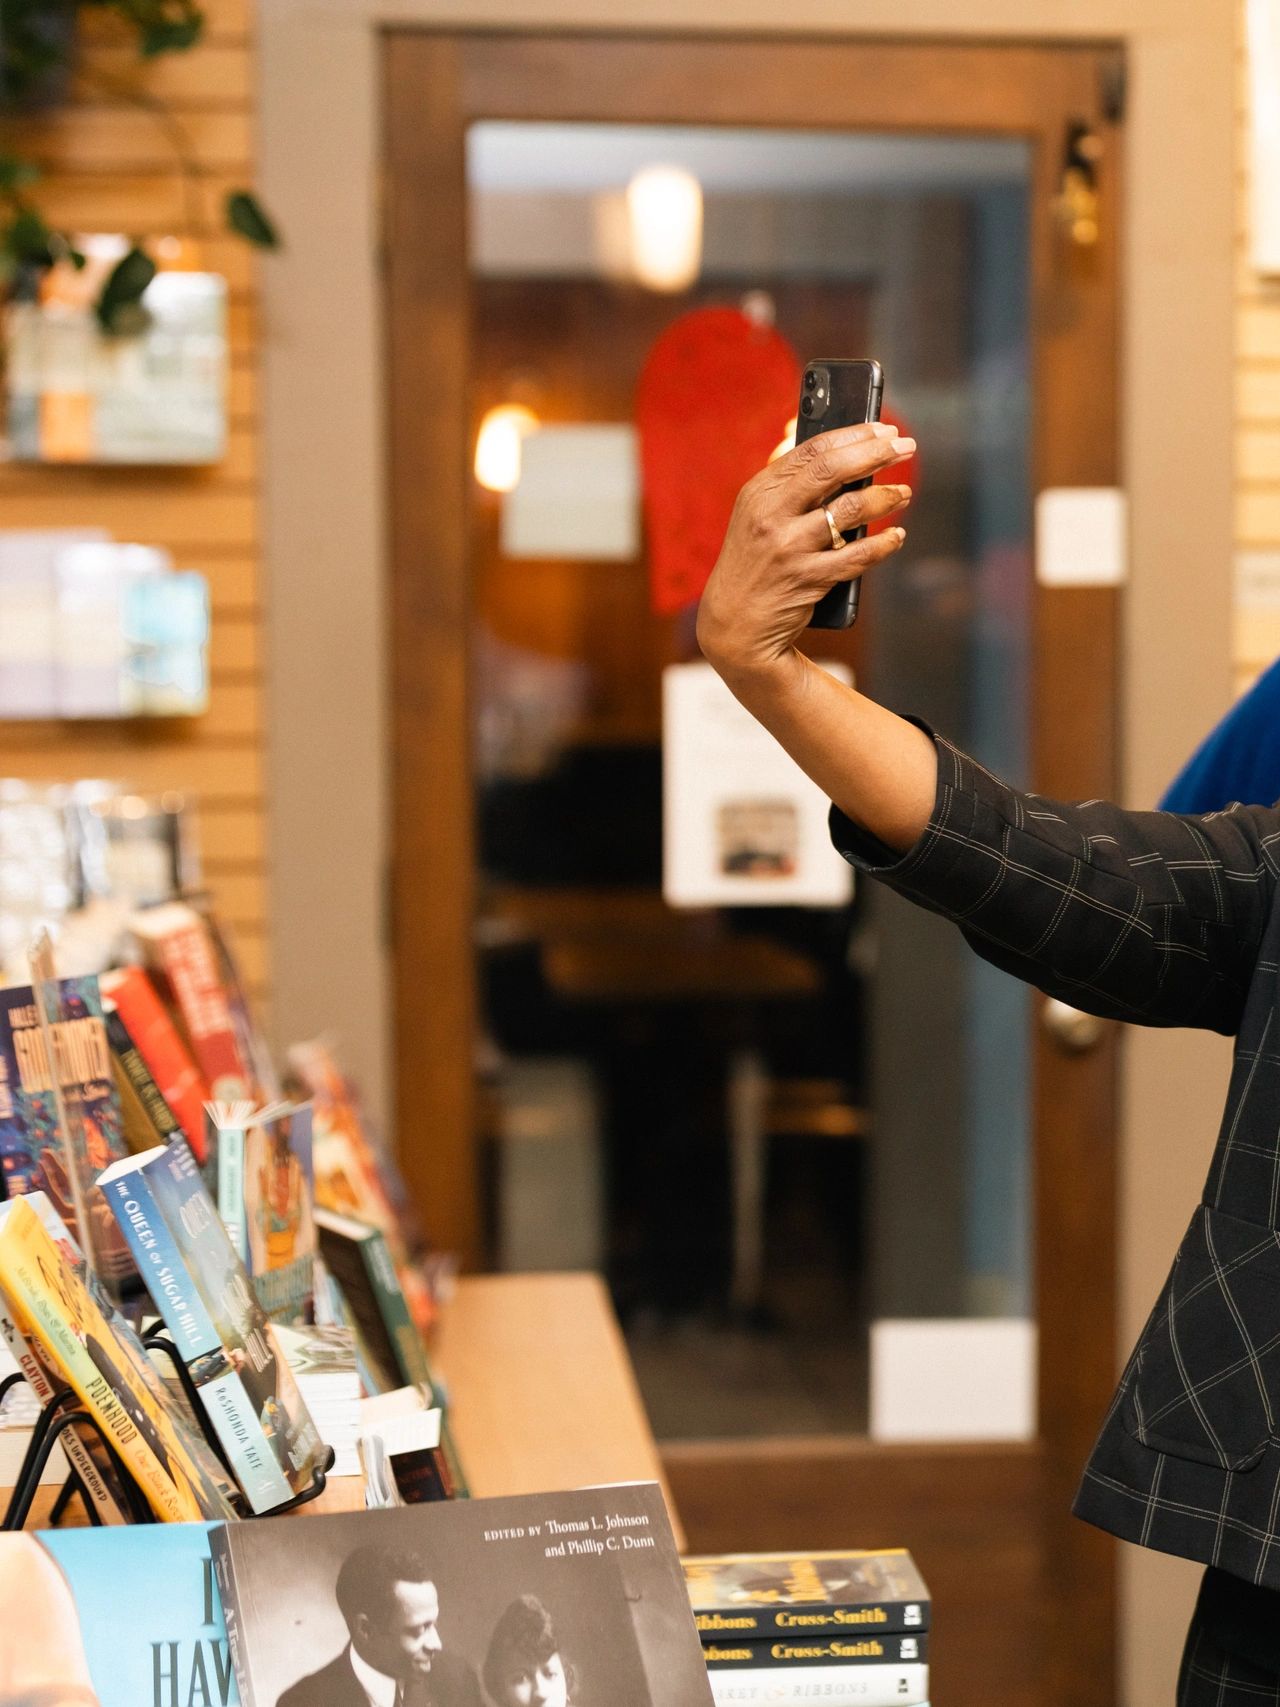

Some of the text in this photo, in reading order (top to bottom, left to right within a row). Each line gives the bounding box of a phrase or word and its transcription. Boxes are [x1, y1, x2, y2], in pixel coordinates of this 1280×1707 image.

[115, 1181, 131, 1199] THE
[124, 1200, 159, 1250] QUEEN
[157, 1267, 188, 1317] SUGAR
[178, 1312, 204, 1348] HILL
[85, 1376, 139, 1445] POEMHOOD
[20, 1354, 50, 1397] CLAYTON
[61, 1427, 74, 1446] OES
[71, 1443, 107, 1502] UNDERGROUND
[484, 1513, 649, 1542] EDITED BY Thomas L. Johnson
[545, 1535, 655, 1557] and Phillip C. Dunn
[775, 1607, 887, 1627] Cross-Smith
[771, 1641, 883, 1659] Cross-Smith
